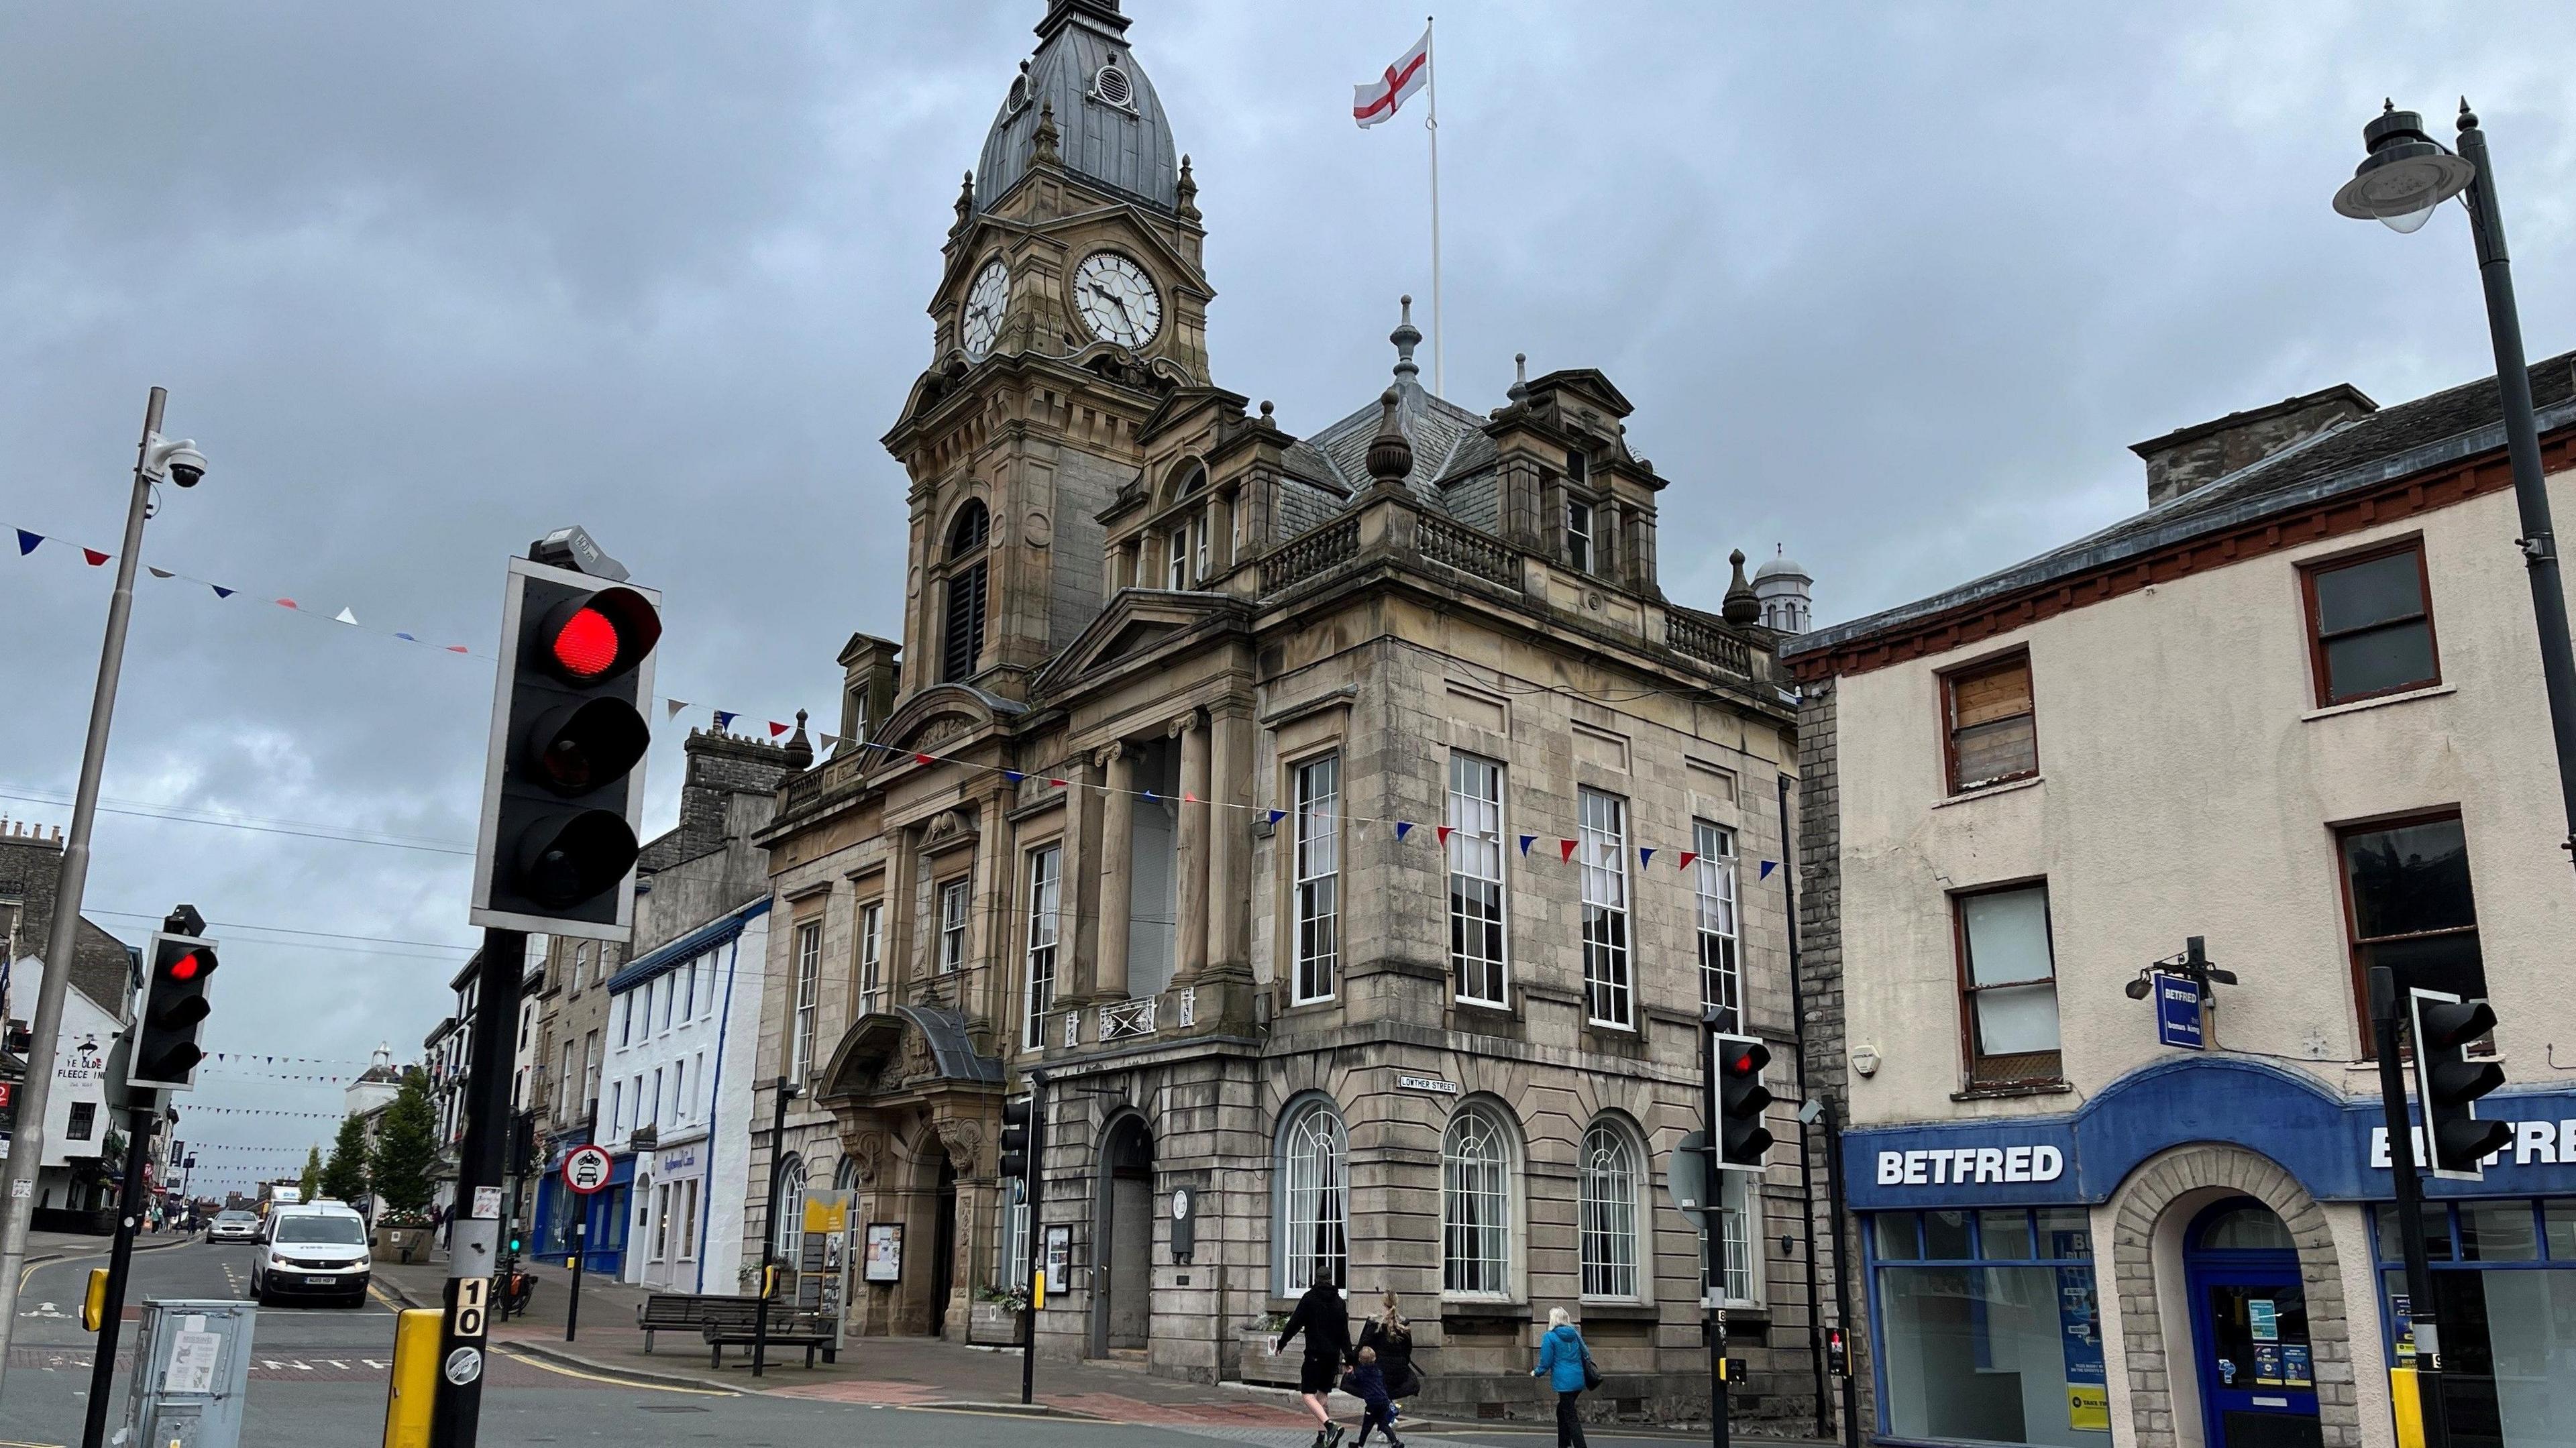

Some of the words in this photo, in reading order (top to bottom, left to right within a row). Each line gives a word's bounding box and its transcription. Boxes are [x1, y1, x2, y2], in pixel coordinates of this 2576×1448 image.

[2165, 989, 2196, 1003] BETFRED
[67, 1059, 76, 1067] YE
[82, 1060, 101, 1068] OLDE
[58, 1069, 88, 1078] FLEECE
[1402, 1078, 1430, 1087] LOWTHER
[1432, 1081, 1454, 1091] STREET
[1878, 1145, 2063, 1185] BETFRED
[1720, 1312, 1726, 1320] 8
